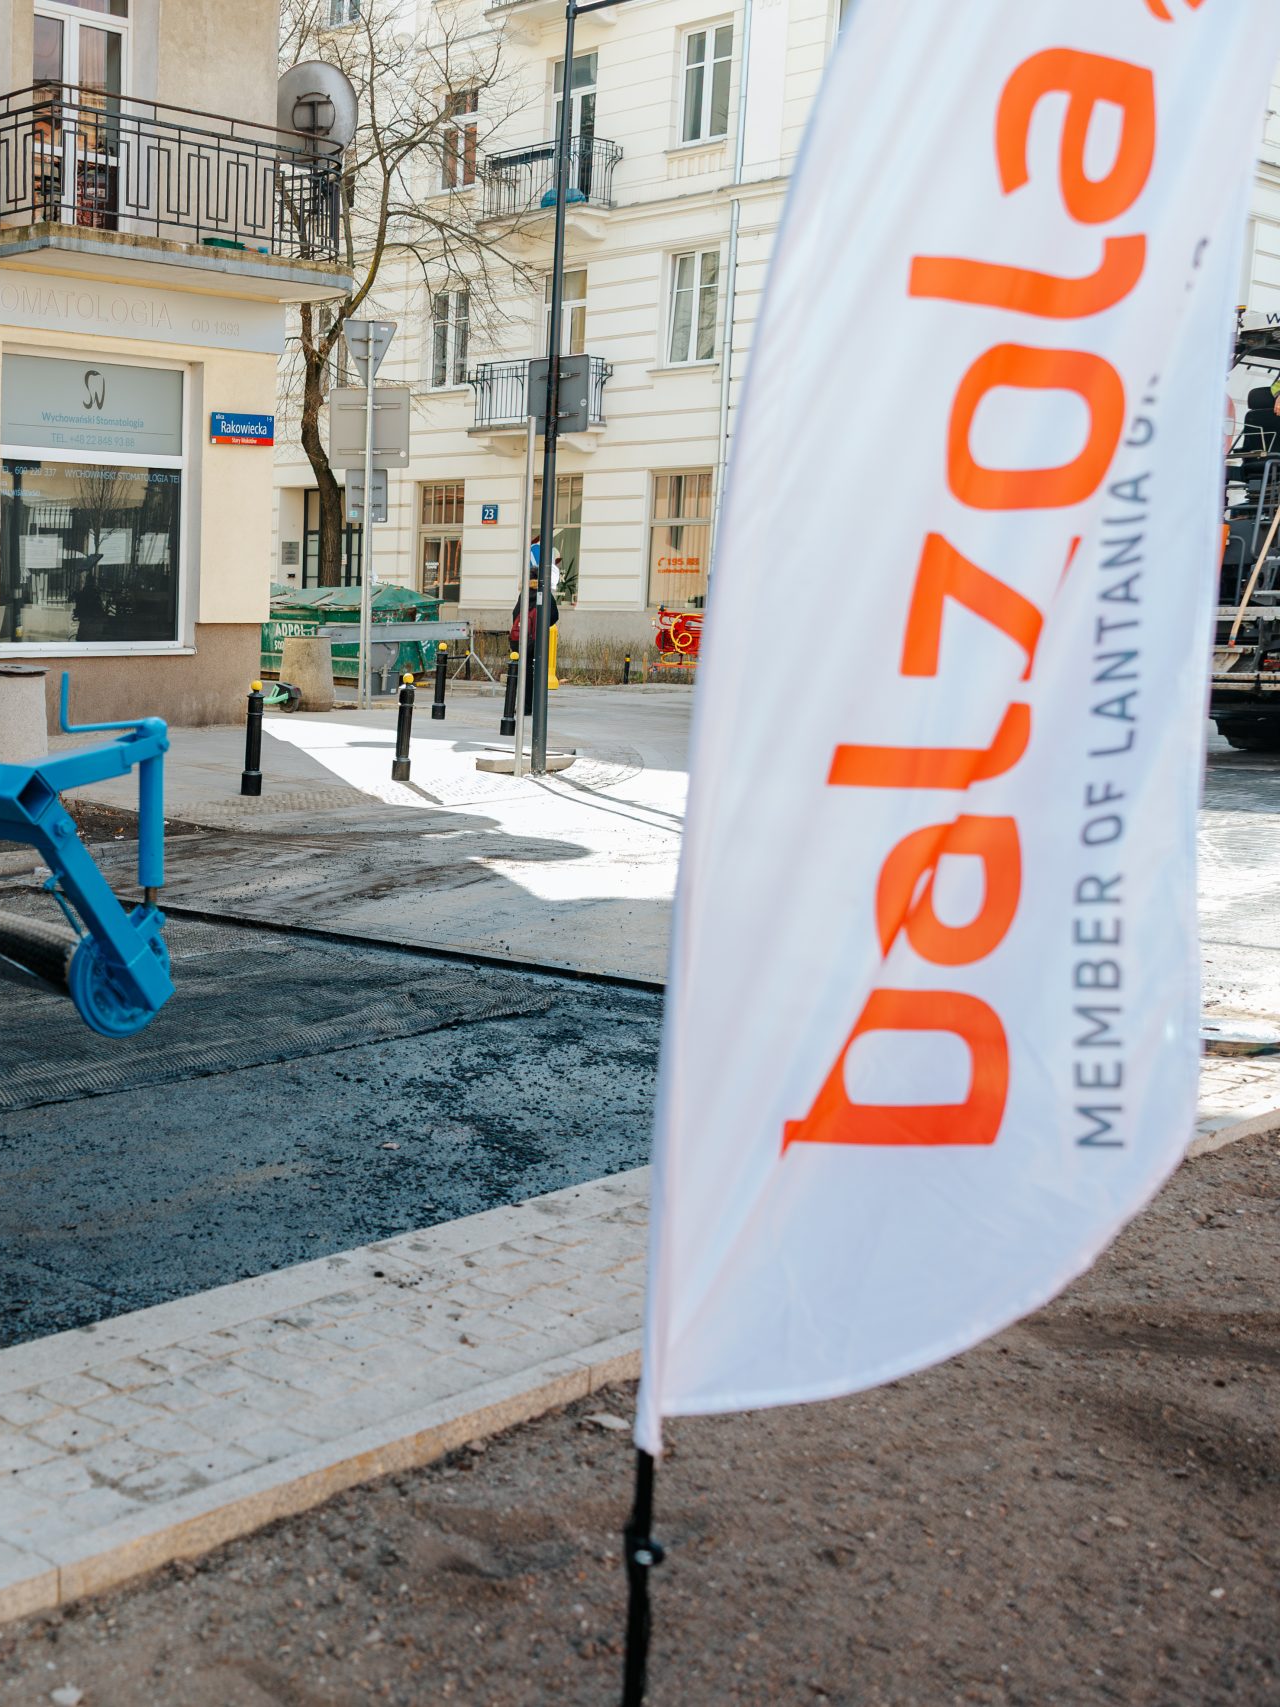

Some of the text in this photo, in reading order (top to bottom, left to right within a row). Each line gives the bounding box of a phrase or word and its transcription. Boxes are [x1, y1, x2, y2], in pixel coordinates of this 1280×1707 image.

[191, 318, 210, 332] OD
[214, 321, 240, 337] 1993
[41, 411, 144, 429] Wychowański Stomatologia
[221, 420, 267, 435] Rakowiecka
[484, 508, 494, 520] 23
[780, 46, 1157, 1158] balzola
[1074, 471, 1151, 1150] MEMBER OF LANTANIA
